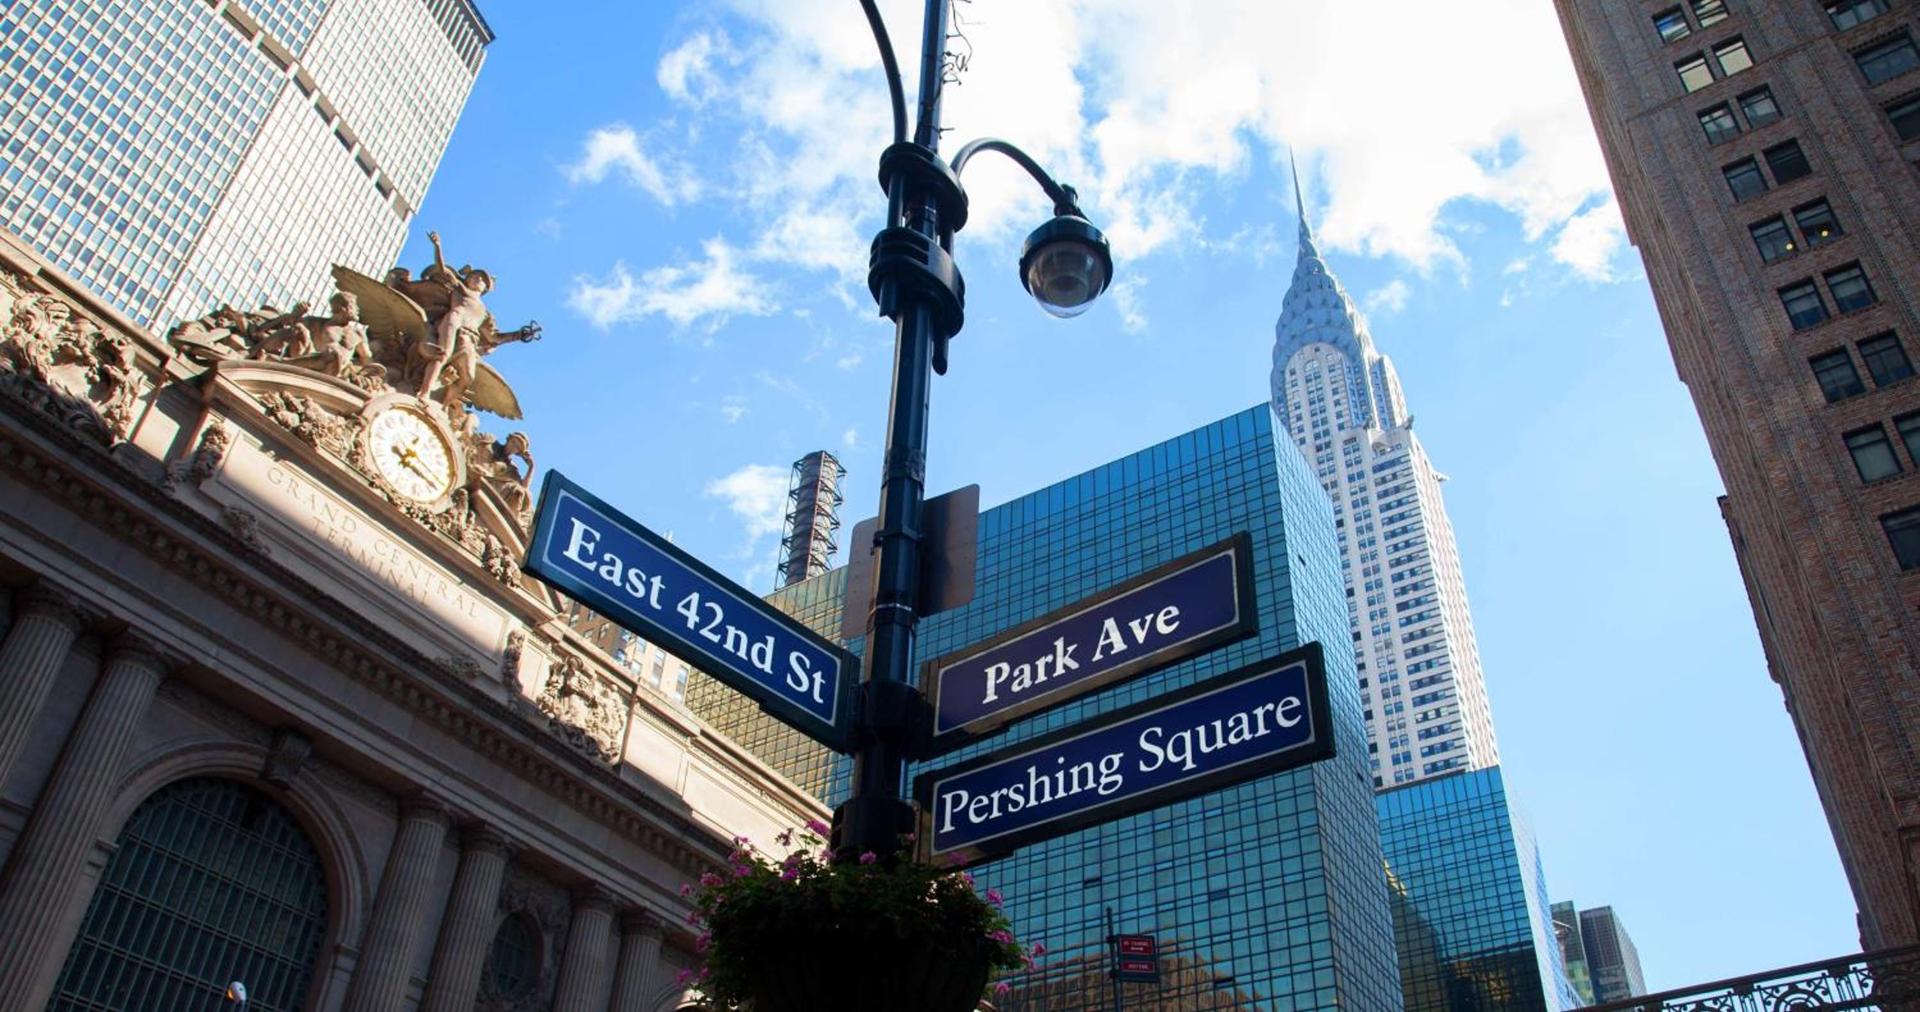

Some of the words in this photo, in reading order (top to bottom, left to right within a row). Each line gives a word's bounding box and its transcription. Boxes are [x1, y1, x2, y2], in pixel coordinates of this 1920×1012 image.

[267, 467, 357, 533] GRAND
[374, 539, 479, 617] CENTRAL
[313, 515, 430, 609] TERMINAL
[562, 516, 666, 610] East
[676, 591, 775, 675] 42nd
[786, 651, 826, 704] St
[982, 625, 1080, 705] Park
[1091, 605, 1180, 662] Ave
[939, 752, 1124, 834] Pershing
[1139, 696, 1302, 772] Square
